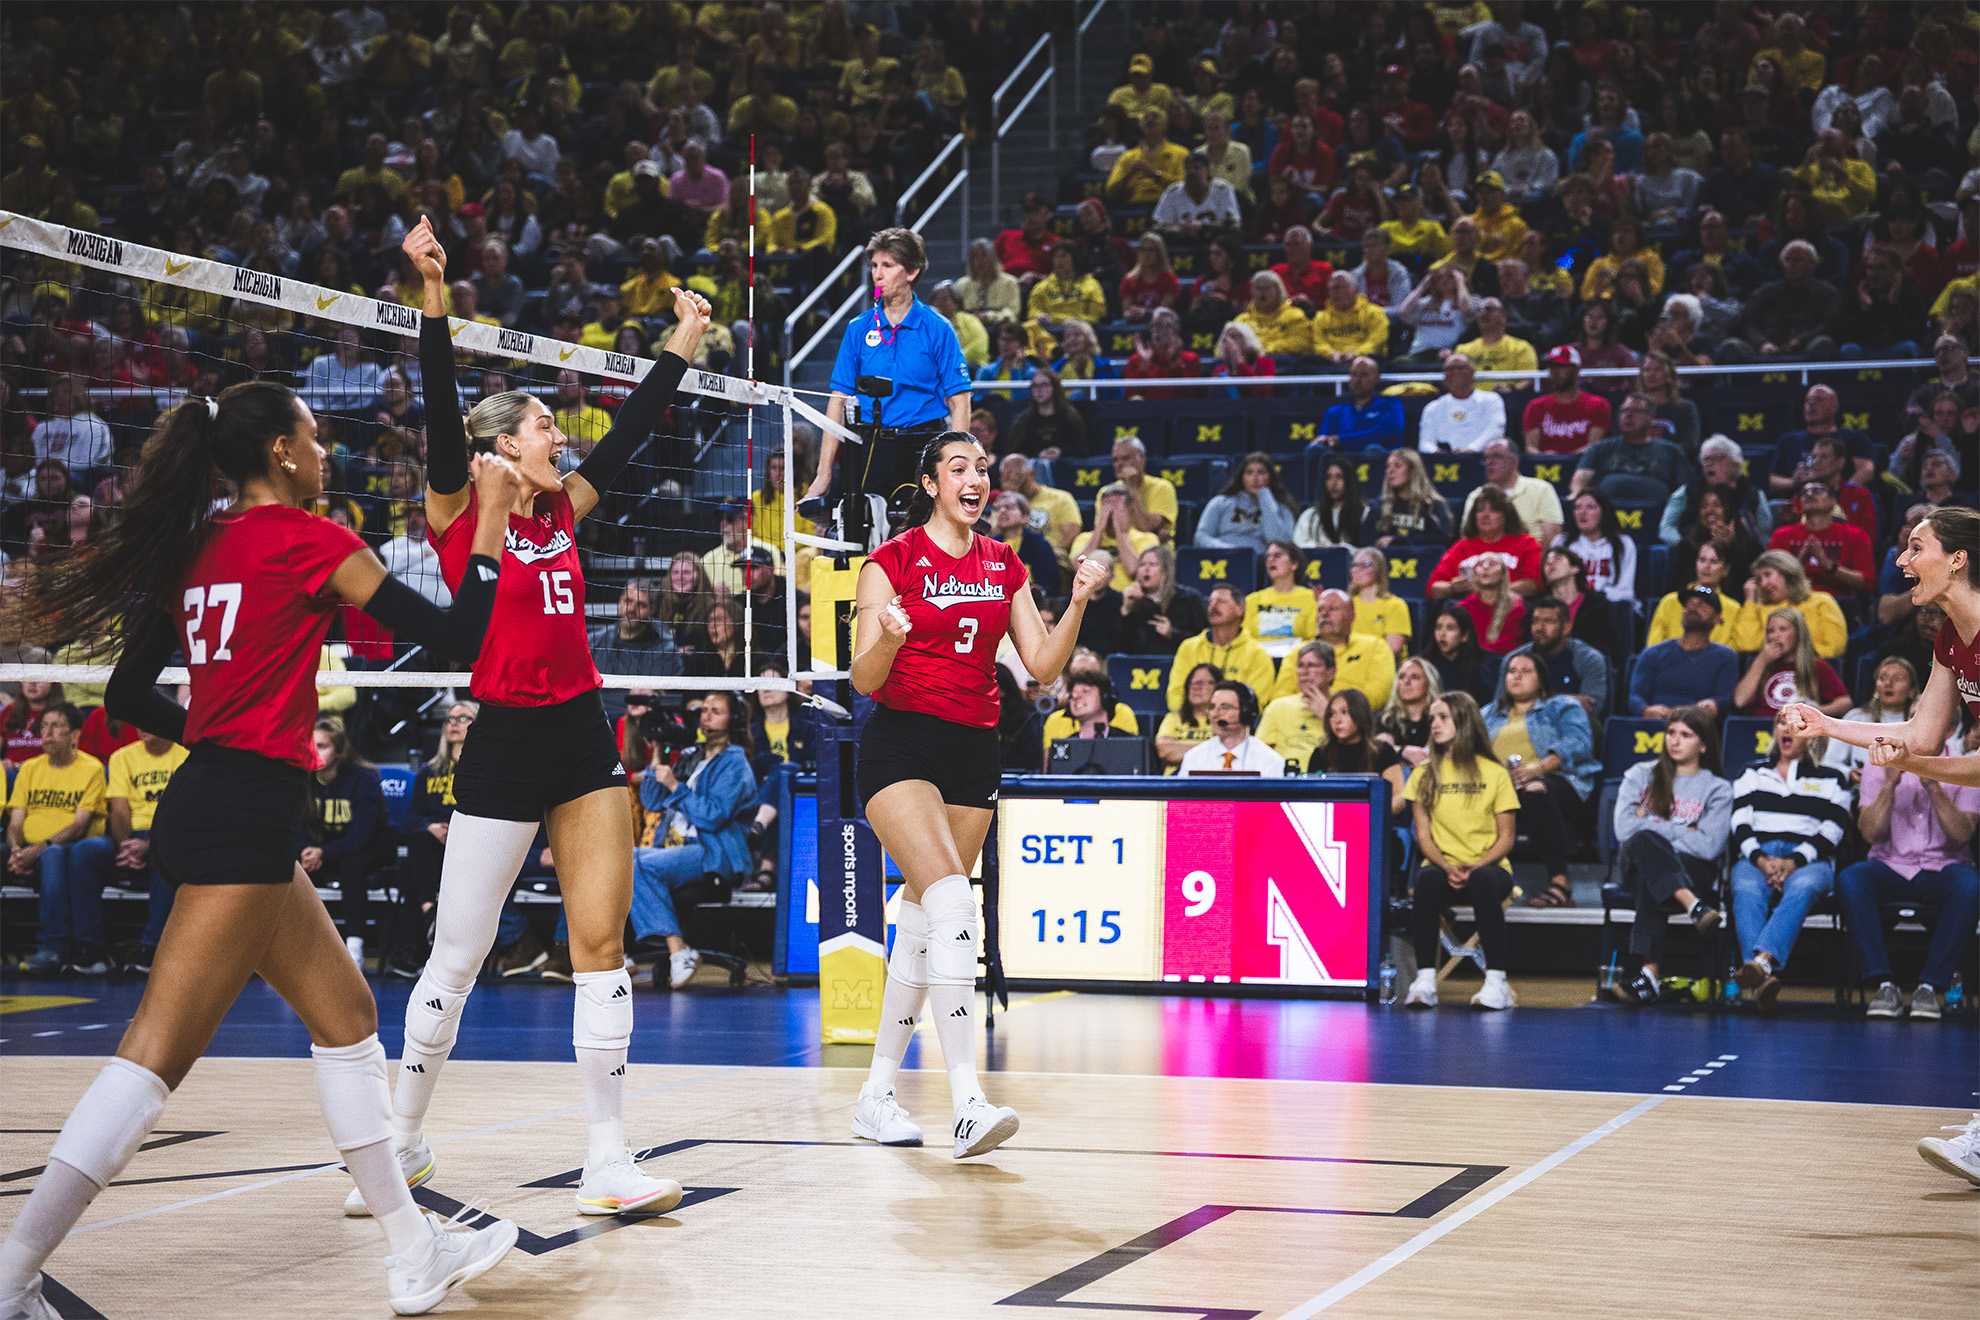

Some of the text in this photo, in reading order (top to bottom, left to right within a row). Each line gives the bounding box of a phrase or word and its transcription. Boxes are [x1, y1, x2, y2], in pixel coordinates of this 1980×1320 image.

[67, 230, 123, 266] MICHIGAN
[233, 268, 282, 300] MICHIGAN
[376, 302, 418, 330] MICHIGAN
[496, 329, 534, 354] MICHIGAN
[1290, 423, 1315, 439] M
[1738, 414, 1764, 431] M
[1842, 413, 1869, 430] M
[1197, 425, 1222, 442] M
[1075, 469, 1101, 486] M
[1161, 469, 1185, 487] M
[1434, 464, 1459, 482] M
[1535, 464, 1562, 482] M
[1616, 510, 1643, 529] M
[1200, 559, 1228, 579] M
[1389, 559, 1417, 578] M
[539, 571, 574, 615] 15
[922, 572, 1005, 601] Nebraska
[183, 582, 242, 665] 27
[954, 617, 979, 654] 3
[1130, 668, 1161, 690] M
[1634, 731, 1665, 753] M
[1021, 835, 1125, 865] SET 1
[842, 824, 858, 927] sports imports
[1181, 870, 1217, 917] 9
[1031, 908, 1122, 944] 1:15
[832, 979, 872, 1010] M
